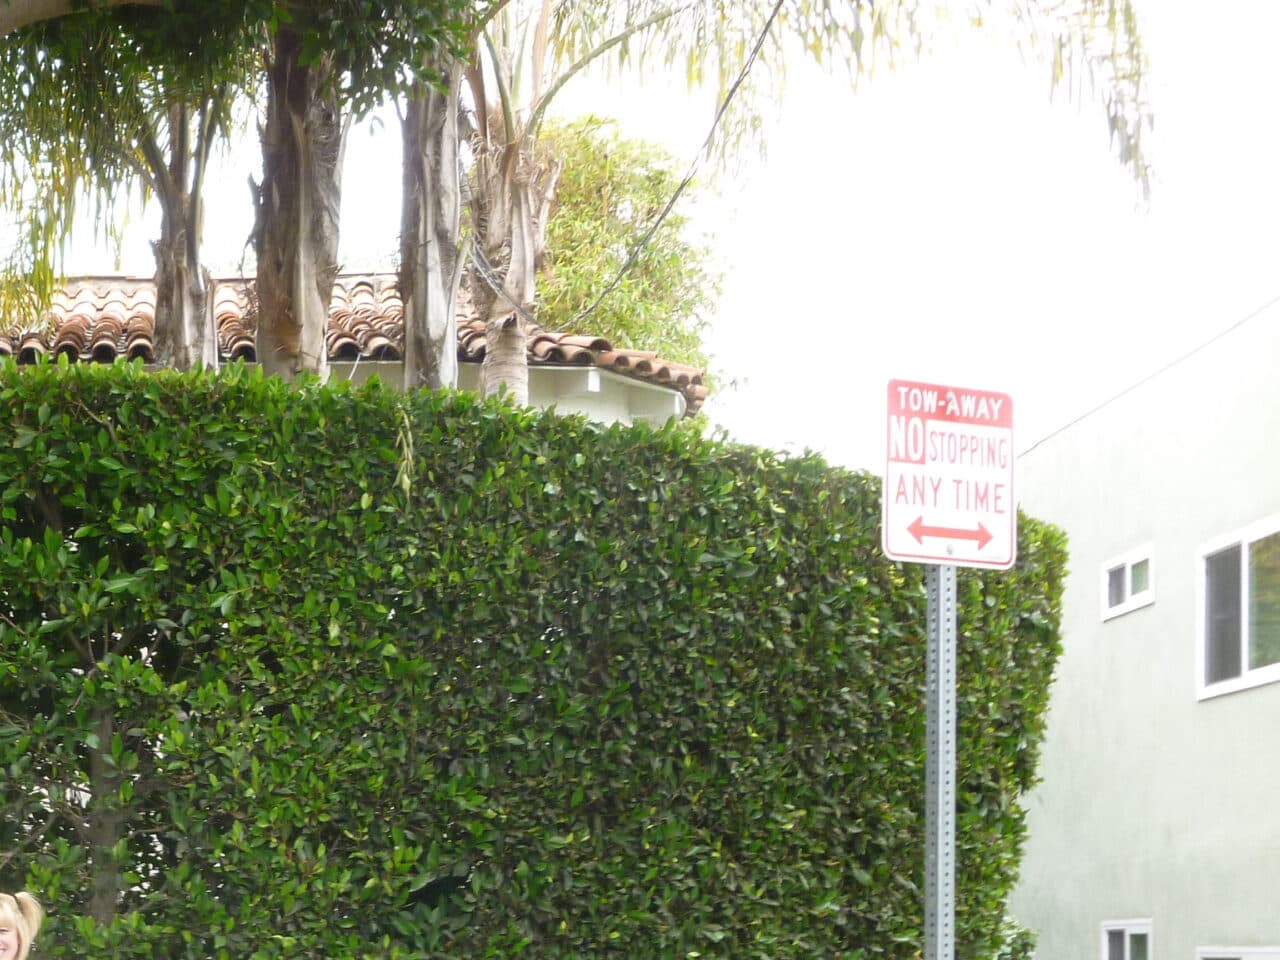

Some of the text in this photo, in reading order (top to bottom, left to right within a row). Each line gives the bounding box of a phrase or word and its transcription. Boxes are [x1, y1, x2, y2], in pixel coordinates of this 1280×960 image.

[896, 386, 1004, 421] TOW-AWAY
[889, 414, 1008, 470] NO STOPPING
[895, 472, 1006, 514] ANY TIME
